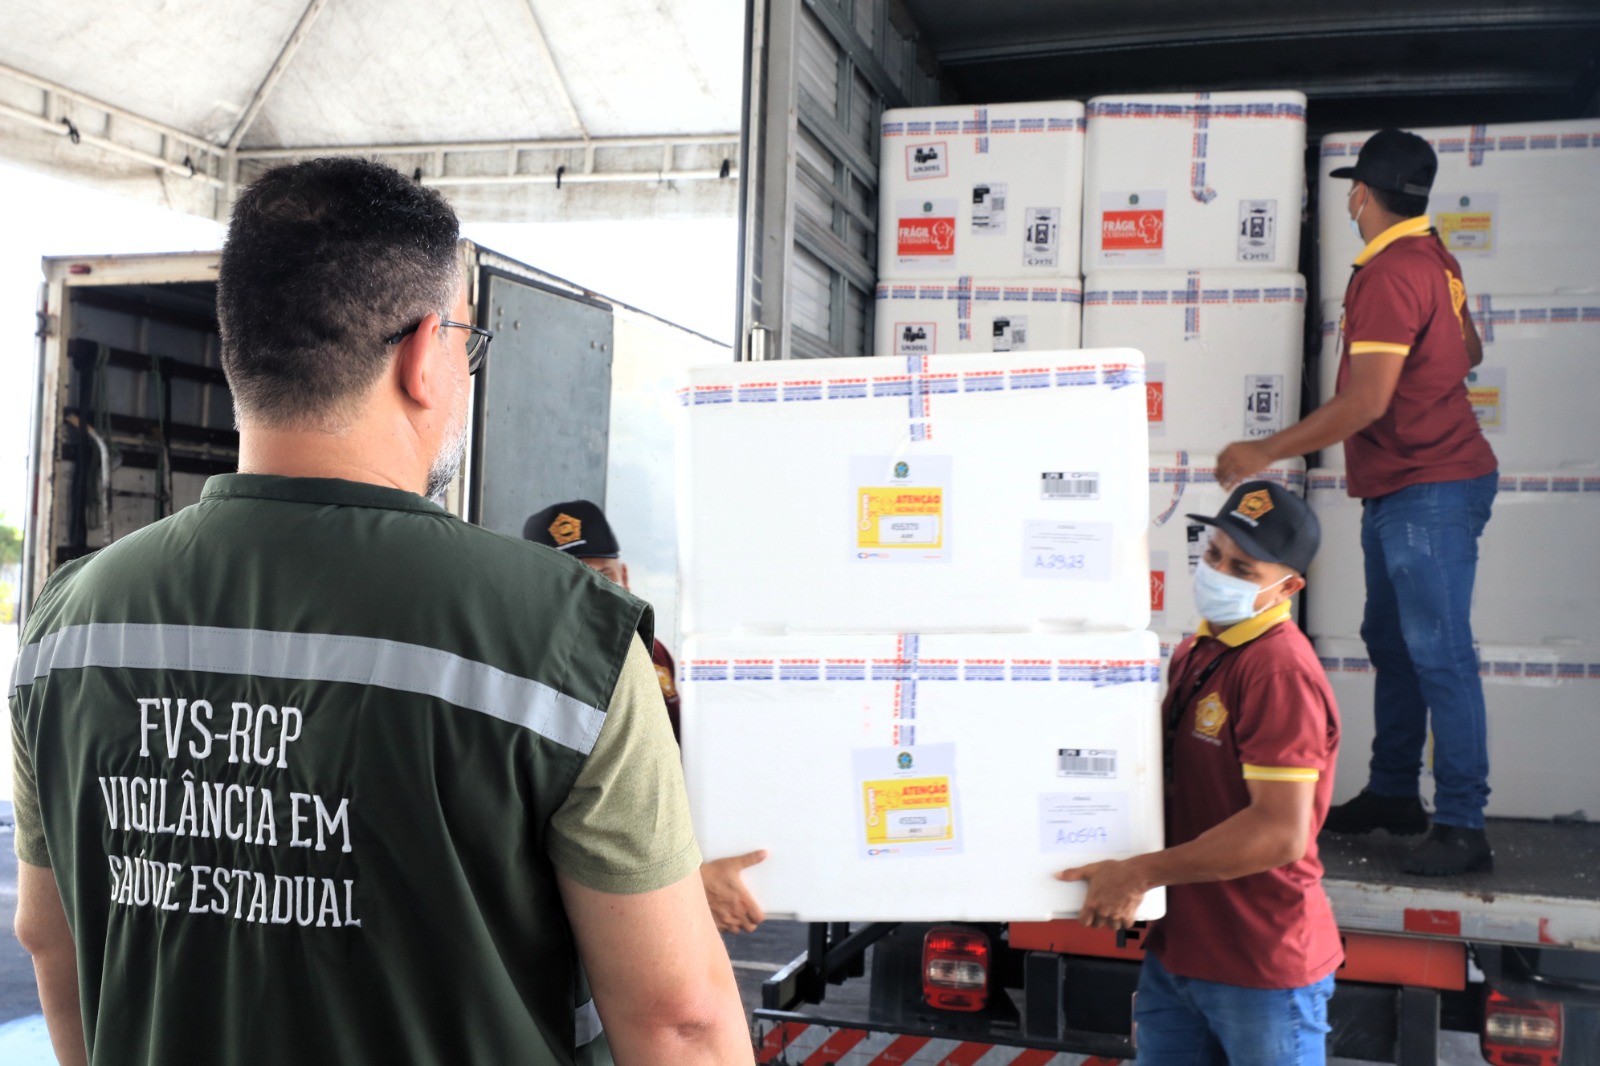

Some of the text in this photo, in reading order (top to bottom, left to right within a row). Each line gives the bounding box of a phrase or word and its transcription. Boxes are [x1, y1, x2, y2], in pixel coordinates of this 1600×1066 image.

[899, 224, 930, 237] FRÁGIL
[1103, 217, 1137, 232] FRÁGIL
[896, 492, 941, 505] ATENÇÃO
[136, 697, 304, 769] FVS-RCP
[901, 781, 949, 797] ATENÇÃO
[98, 768, 353, 853] VIGILÂNCIA EM
[107, 848, 362, 928] SAÚDE ESTADUAL
